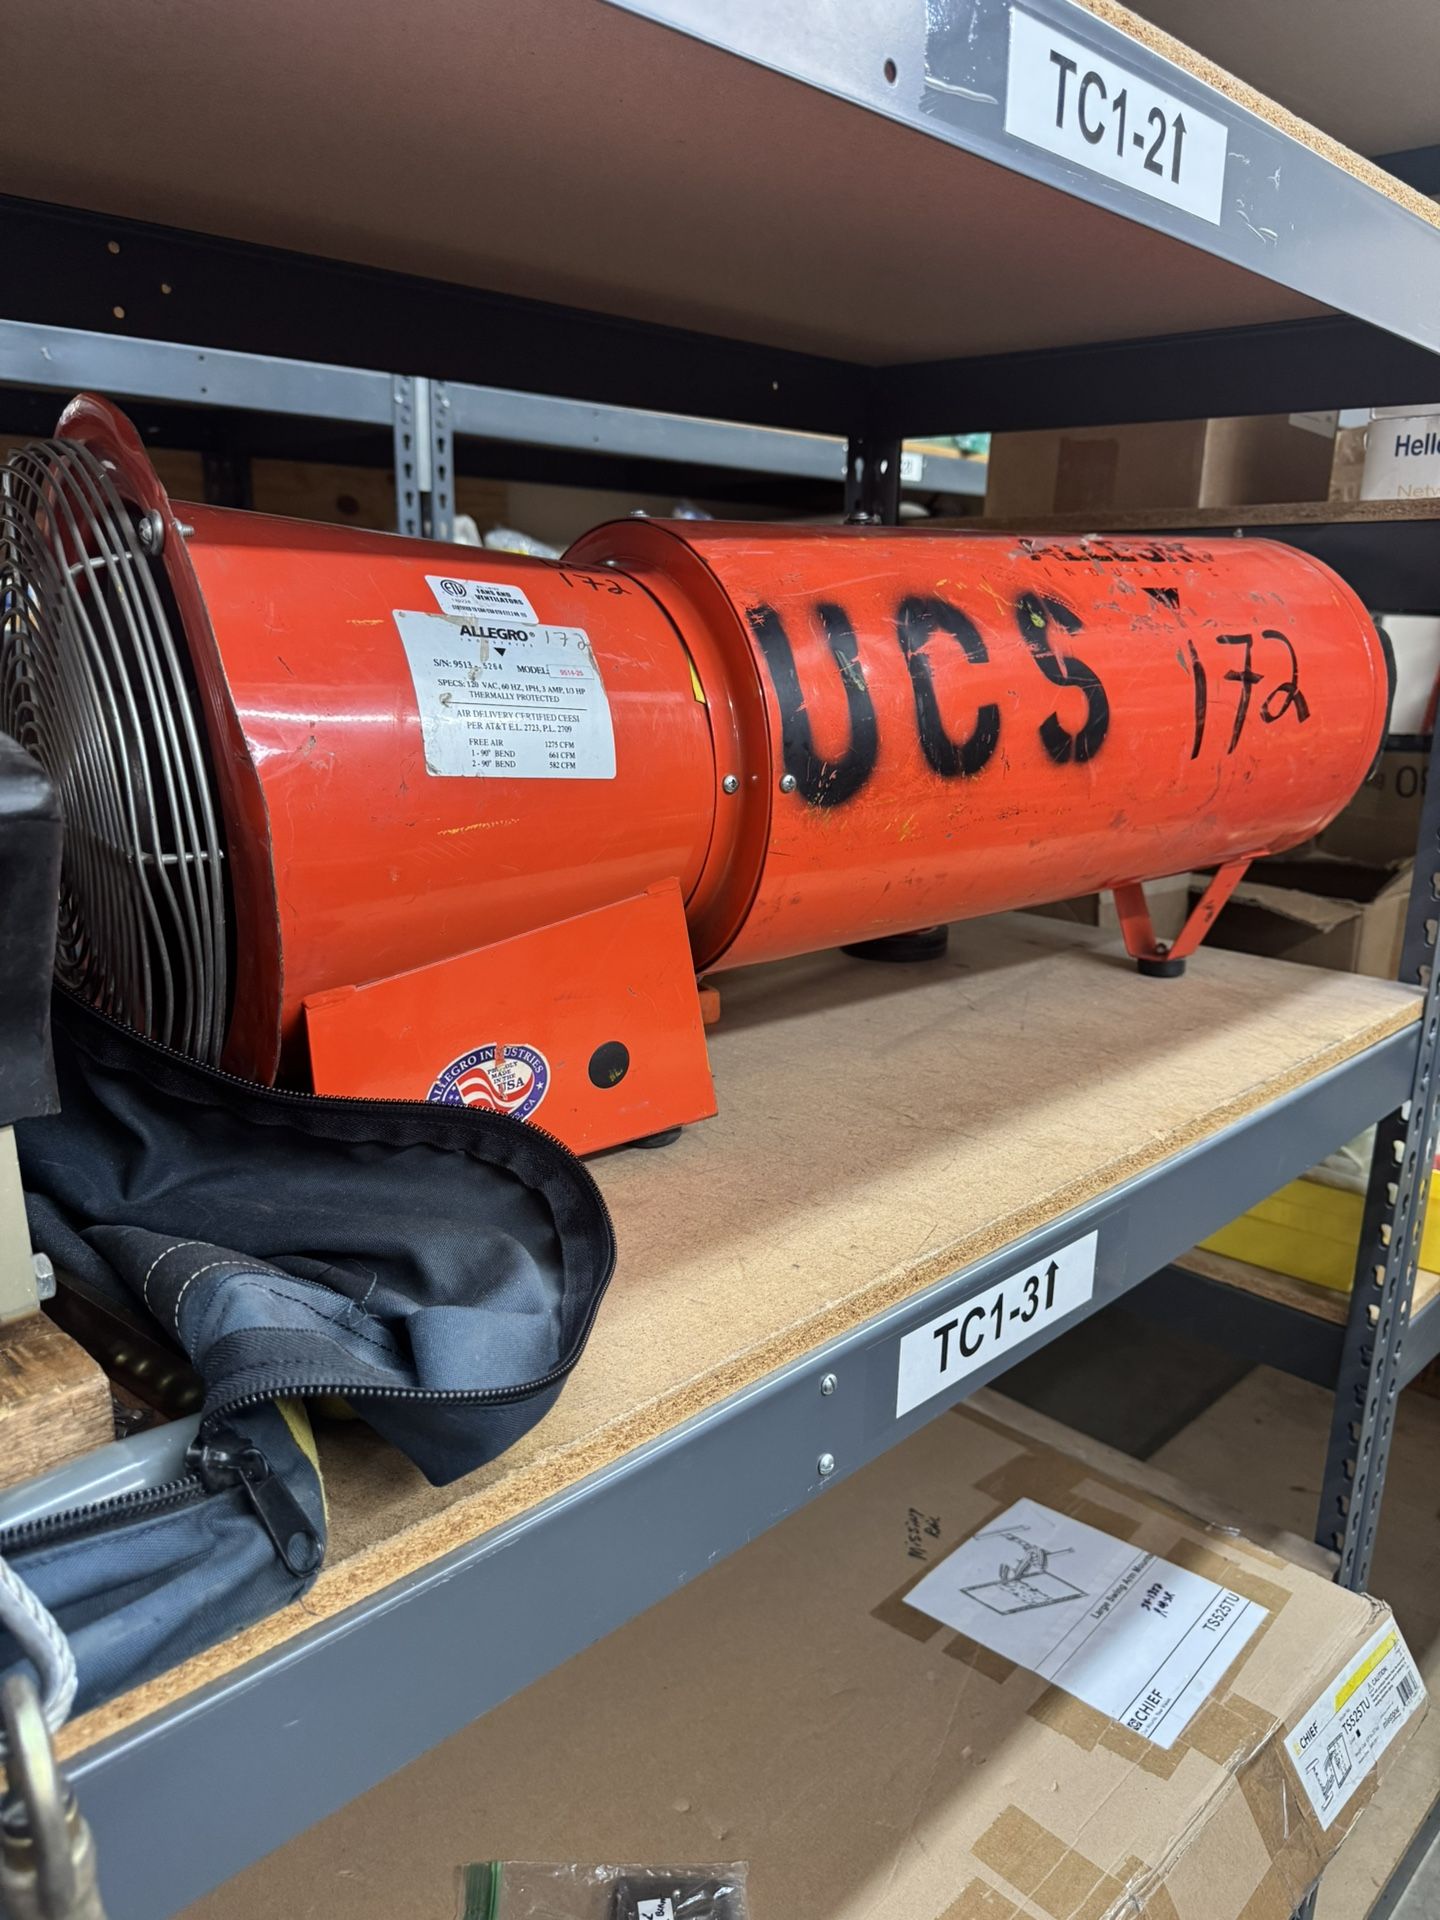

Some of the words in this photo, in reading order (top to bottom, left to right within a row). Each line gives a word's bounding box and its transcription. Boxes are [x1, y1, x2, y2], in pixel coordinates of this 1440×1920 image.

[1049, 48, 1167, 178] TC1-2
[558, 571, 633, 595] 172
[474, 594, 524, 606] VENTILATORS
[475, 588, 496, 597] FANS
[497, 590, 512, 598] AND
[544, 630, 591, 650] 172
[437, 678, 466, 688] SPECS:
[466, 680, 480, 688] 120
[469, 690, 515, 700] THERMALLY
[516, 693, 560, 702] PROTECTED
[748, 592, 1111, 807] UCS
[1184, 629, 1311, 760] 172
[456, 709, 472, 718] AIR
[472, 709, 514, 719] DELIVERY
[515, 711, 557, 722] CERTIFIED
[466, 721, 484, 730] PER
[484, 722, 506, 731] AT&T
[468, 738, 490, 746] FREE
[490, 738, 504, 747] AIR
[559, 741, 575, 749] CFM
[494, 750, 516, 758] BEND
[548, 751, 560, 759] 661
[560, 751, 576, 759] CFM
[495, 760, 517, 768] BEND
[549, 761, 560, 769] 582
[560, 761, 576, 769] CFM
[479, 1046, 545, 1075] INUSTRIES
[933, 1275, 1040, 1374] TC1-3
[1090, 1595, 1111, 1620] Large
[1105, 1582, 1128, 1602] Swing
[1122, 1573, 1135, 1586] Arm
[1201, 1592, 1241, 1632] TS525TU
[1134, 1687, 1164, 1723] CHIEF
[1341, 1696, 1371, 1735] TS525TU
[1299, 1721, 1319, 1750] CHIEF
